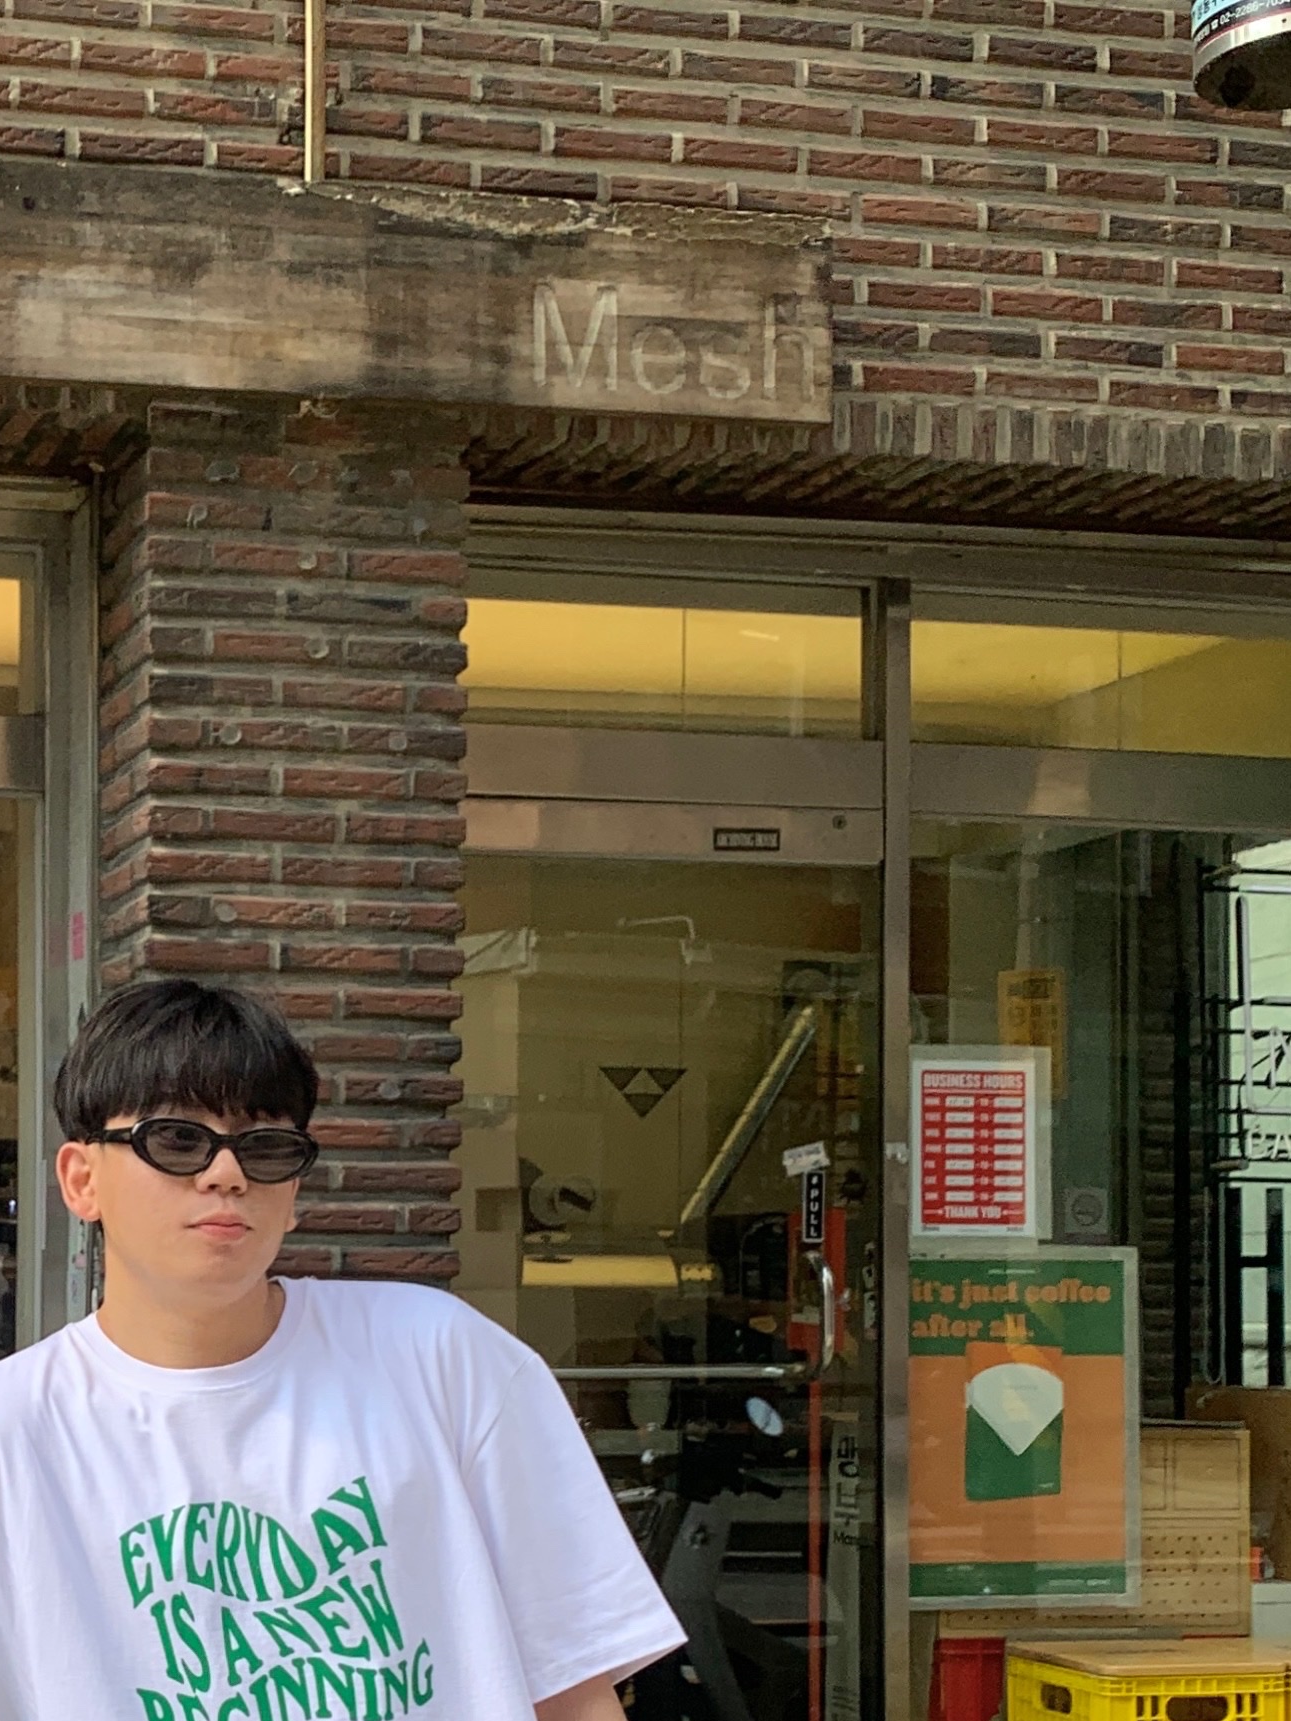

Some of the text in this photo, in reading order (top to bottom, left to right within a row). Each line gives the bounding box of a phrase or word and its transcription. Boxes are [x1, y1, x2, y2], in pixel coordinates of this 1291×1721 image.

[533, 281, 814, 401] Mesh
[923, 1073, 1023, 1089] BUSINESS HOURS
[810, 1188, 819, 1236] PULL
[945, 1205, 1001, 1218] THANK YOU
[911, 1278, 1110, 1310] it's just coffee
[912, 1313, 983, 1338] after
[118, 1475, 388, 1609] EVERYDAY
[150, 1558, 404, 1693] IS A NEW
